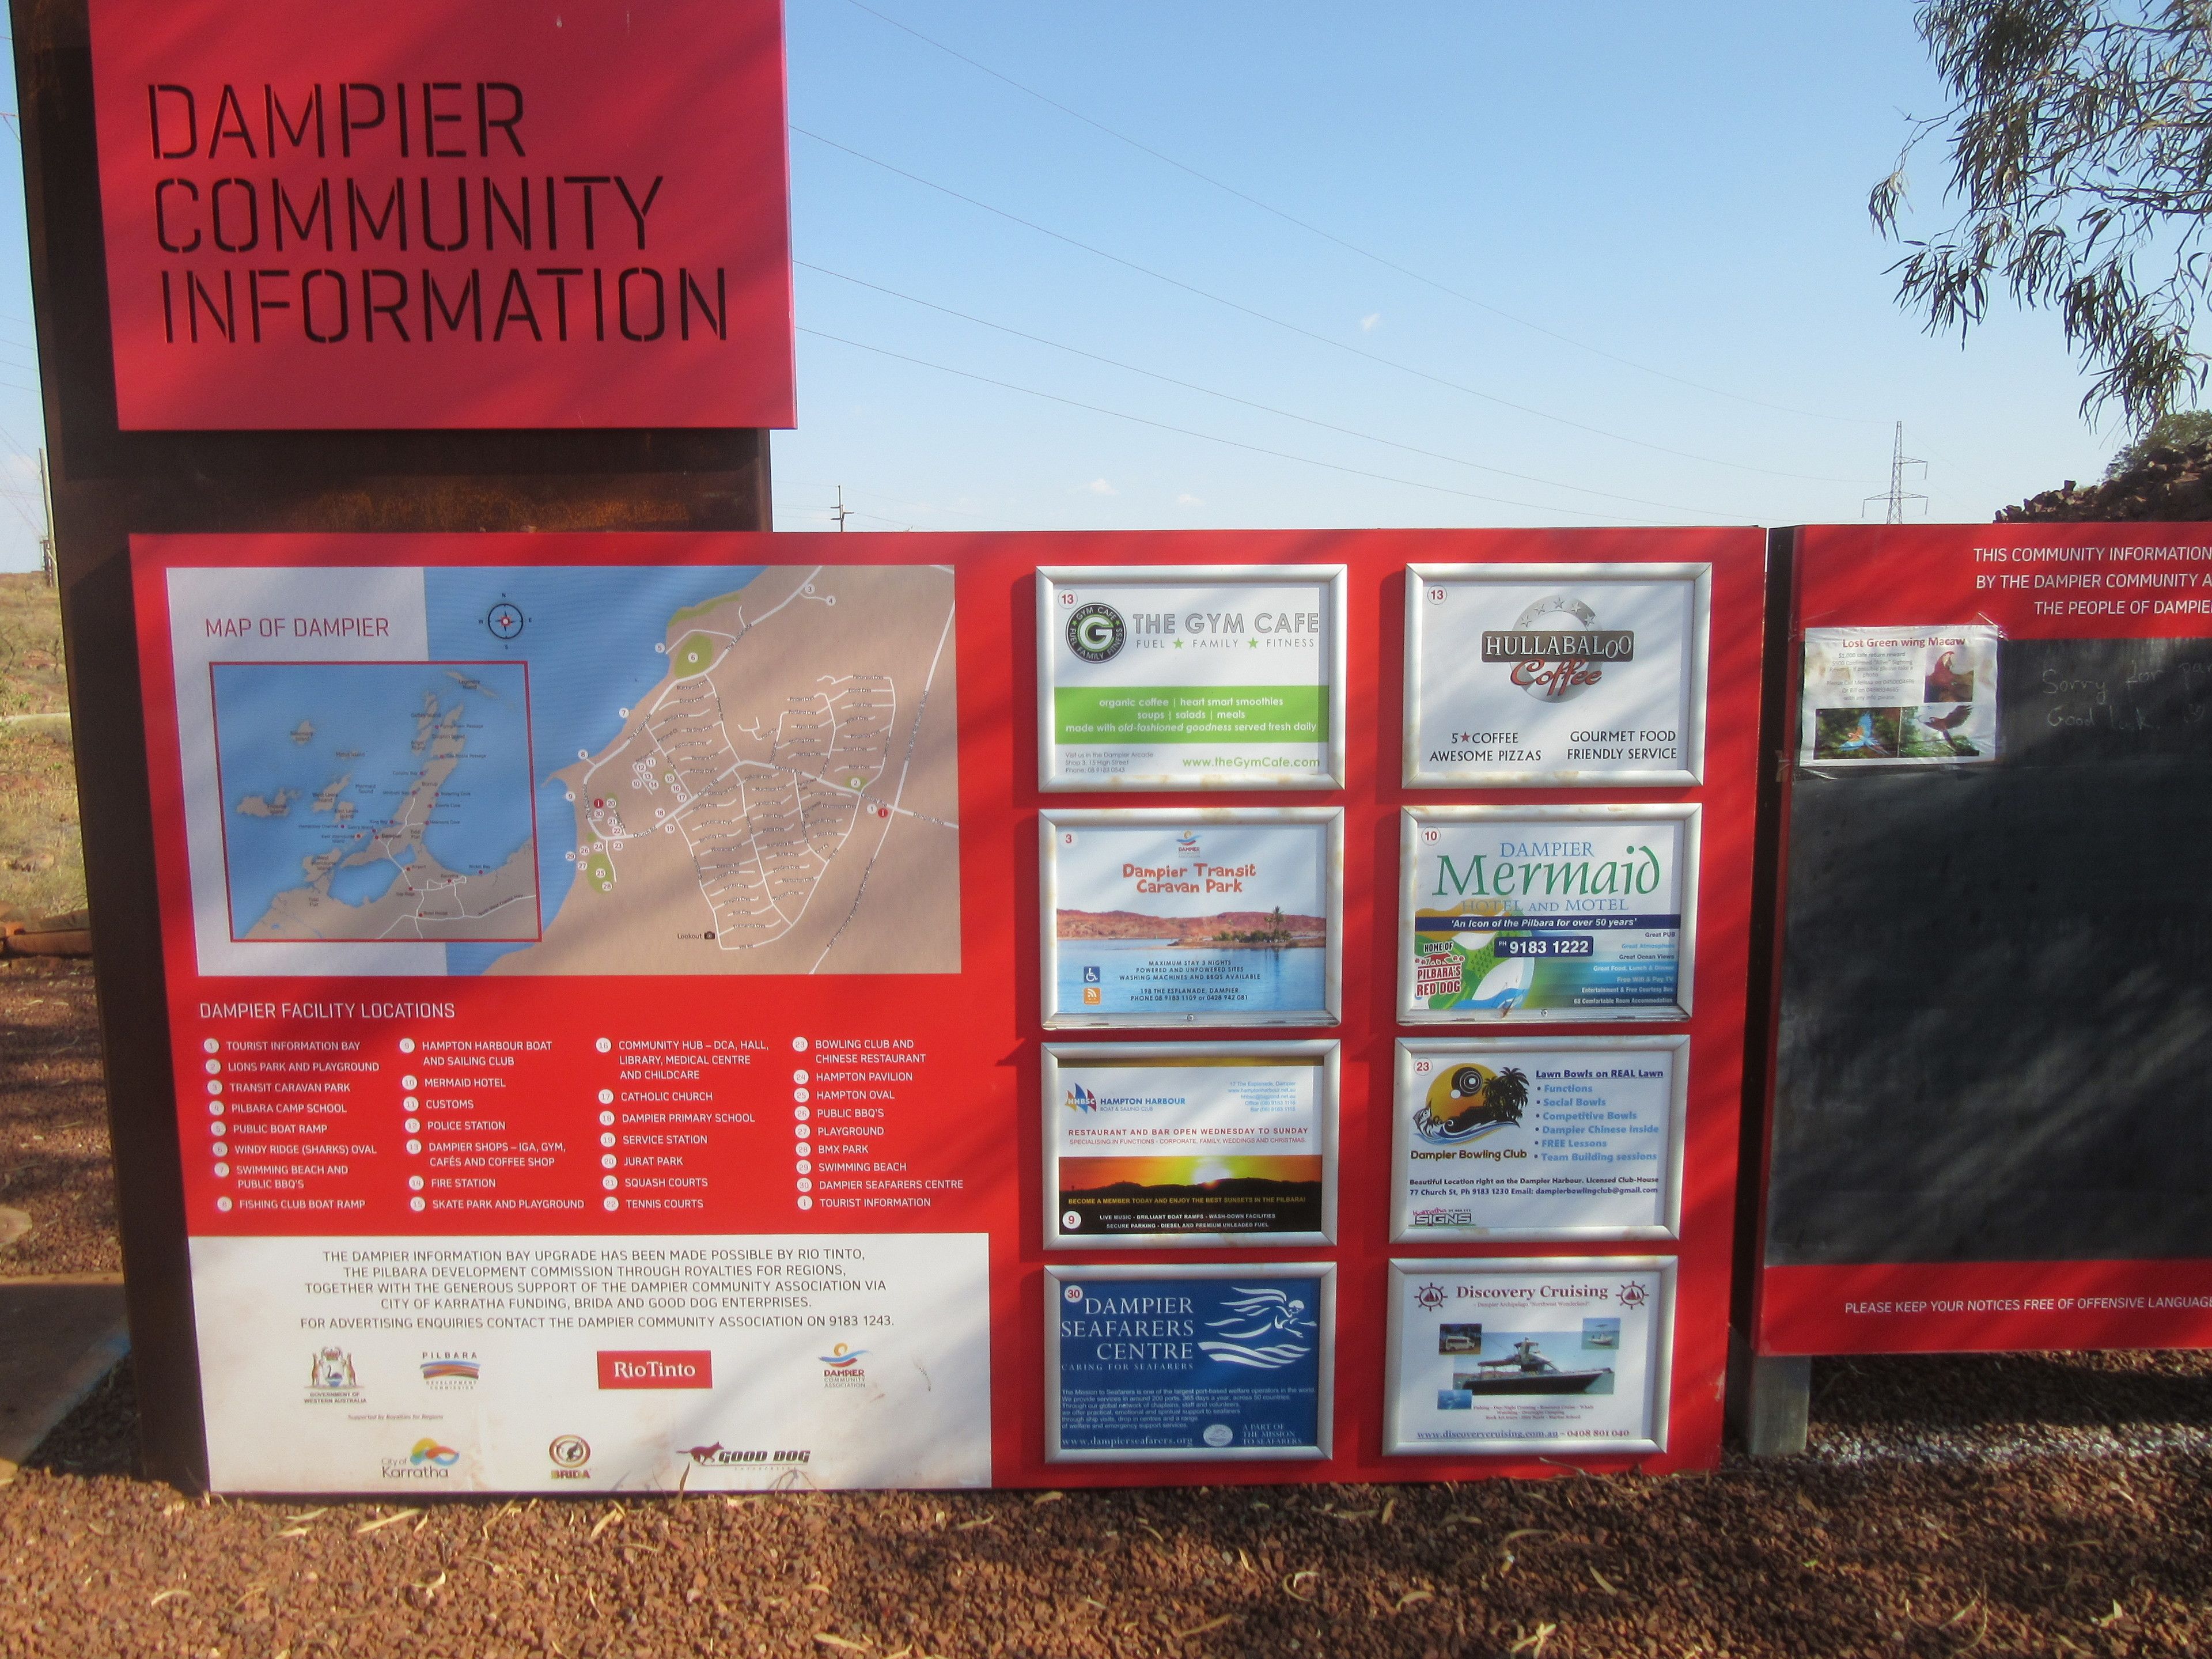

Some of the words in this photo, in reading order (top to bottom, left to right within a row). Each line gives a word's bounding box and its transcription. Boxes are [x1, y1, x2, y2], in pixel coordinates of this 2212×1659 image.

[149, 82, 525, 159] DAMPIER
[156, 175, 662, 253] COMMUNITY
[162, 267, 726, 344] INFORMATION
[1974, 548, 2006, 562] THIS
[2012, 548, 2104, 562] COMMUNITY
[2110, 547, 2212, 560] INFORMATION
[1976, 575, 1995, 589] BY
[2001, 575, 2029, 588] THE
[2035, 574, 2100, 588] DAMPIER
[2106, 574, 2198, 588] COMMUNITY
[1062, 594, 1074, 604] 13
[1431, 590, 1443, 600] 13
[2035, 601, 2063, 615] THE
[2069, 601, 2125, 615] PEOPLE
[2130, 600, 2149, 614] OF
[2154, 600, 2212, 613] DAMPIE
[206, 619, 251, 637] MAP
[260, 619, 285, 637] OF
[294, 618, 388, 637] DAMPIER
[1133, 613, 1175, 634] THE
[1185, 613, 1244, 634] GYM
[1254, 612, 1319, 634] CAFE
[1137, 639, 1164, 649] FUEL
[1193, 639, 1238, 648] FAMILY
[1267, 638, 1313, 647] FITNESS
[1485, 635, 1633, 658] HULLABALOO
[1843, 639, 1863, 647] Lost
[1867, 638, 1897, 647] Green
[1901, 638, 1925, 648] wing
[1927, 637, 1965, 647] Macaw
[1510, 658, 1603, 696] Coffee
[1100, 698, 1135, 708] organic
[1138, 698, 1168, 706] coffee
[1207, 698, 1233, 706] smart
[2047, 704, 2095, 728] Good
[1571, 730, 1635, 742] GOURMET
[1641, 730, 1676, 741] FOOD
[1430, 751, 1492, 761] AWESOME
[1499, 750, 1540, 761] PIZZAS
[1568, 748, 1623, 759] FRIENDLY
[1628, 748, 1676, 759] SERVICE
[1183, 755, 1320, 769] www.theGymCafe.com
[775, 764, 794, 773] Central
[697, 782, 713, 796] Church
[711, 778, 719, 786] Rd
[1066, 834, 1071, 843] 3
[1426, 831, 1437, 840] 10
[1501, 842, 1593, 857] DAMPIER
[1123, 863, 1188, 882] Dampier
[1194, 863, 1256, 881] Transit
[1433, 845, 1660, 895] Mermaid
[1137, 879, 1199, 893] Caravan
[1206, 878, 1243, 892] Park
[1461, 900, 1524, 913] HOTEL
[1529, 903, 1559, 911] AND
[1565, 899, 1628, 911] MOTEL
[1510, 941, 1546, 954] 9183
[1553, 941, 1588, 953] 1222
[1418, 967, 1461, 980] PILBARA'S
[1417, 983, 1437, 997] RED
[1439, 982, 1461, 994] DOG
[200, 1003, 275, 1017] DAMPIER
[282, 1003, 354, 1018] FACILITY
[362, 1003, 454, 1018] LOCATIONS
[228, 1042, 267, 1050] TOURIST
[271, 1041, 338, 1050] INFORMATION
[342, 1042, 359, 1050] BAY
[1416, 1062, 1429, 1071] 23
[1562, 1070, 1592, 1078] Bowls
[425, 1078, 471, 1087] MERMAID
[474, 1078, 505, 1087] HOTEL
[621, 1092, 668, 1101] CATHOLIC
[672, 1092, 713, 1101] CHURCH
[1543, 1098, 1573, 1106] Social
[1576, 1097, 1605, 1106] Bowls
[426, 1100, 474, 1108] CUSTOMS
[622, 1114, 666, 1122] DAMPIER
[669, 1113, 712, 1122] PRIMARY
[715, 1113, 755, 1122] SCHOOL
[428, 1122, 461, 1130] POLICE
[465, 1121, 506, 1130] STATION
[1411, 1150, 1457, 1161] Dampier
[1460, 1150, 1501, 1161] Bowling
[1503, 1149, 1527, 1158] Club
[625, 1179, 666, 1187] SQUASH
[668, 1178, 708, 1187] COURTS
[820, 1199, 861, 1207] TOURIST
[864, 1198, 930, 1207] INFORMATION
[1069, 1215, 1075, 1224] 9
[1415, 1213, 1472, 1225] SIGNS
[324, 1252, 347, 1261] THE
[353, 1251, 408, 1261] DAMPIER
[414, 1251, 501, 1261] INFORMATION
[507, 1251, 529, 1260] BAY
[535, 1251, 596, 1261] UPGRADE
[601, 1251, 627, 1260] HAS
[632, 1251, 665, 1260] BEEN
[671, 1251, 706, 1260] MADE
[712, 1249, 772, 1260] POSSIBLE
[778, 1249, 793, 1259] BY
[798, 1249, 819, 1259] RIO
[824, 1249, 864, 1260] TINTO,
[1068, 1290, 1080, 1298] 30
[1456, 1285, 1535, 1301] Discovery
[1540, 1285, 1608, 1300] Cruising
[1086, 1297, 1192, 1314] DAMPIER
[1846, 1302, 1892, 1313] PLEASE
[1896, 1302, 1927, 1312] KEEP
[1931, 1301, 1963, 1312] YOUR
[1968, 1300, 2020, 1311] NOTICES
[2023, 1300, 2054, 1309] FREE
[2058, 1300, 2074, 1309] OF
[2078, 1298, 2143, 1309] OFFENSIVE
[1062, 1321, 1193, 1336] SEAFARERS
[1097, 1343, 1192, 1359] CENTRE
[1063, 1436, 1192, 1448] www.dampierseafarers.org
[719, 1452, 768, 1463] GOOD
[774, 1451, 810, 1463] DOG
[382, 1467, 448, 1478] Karratha
